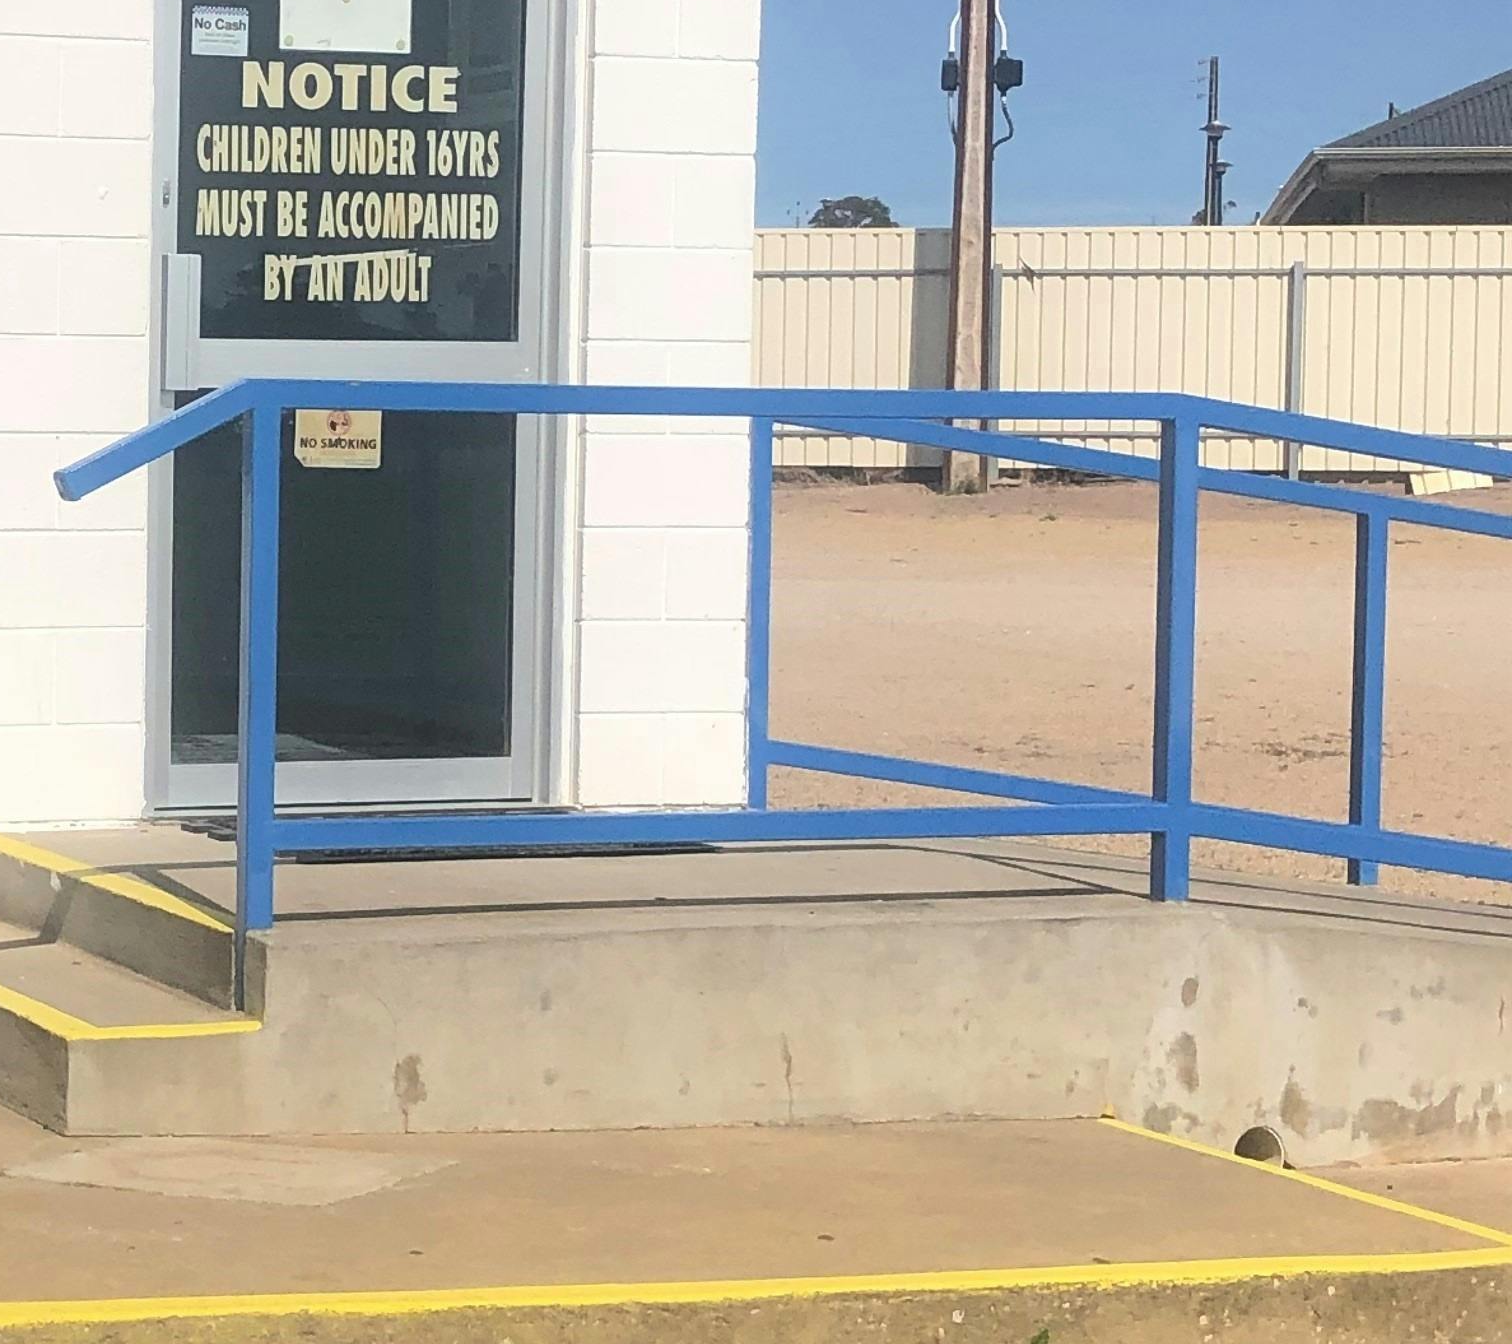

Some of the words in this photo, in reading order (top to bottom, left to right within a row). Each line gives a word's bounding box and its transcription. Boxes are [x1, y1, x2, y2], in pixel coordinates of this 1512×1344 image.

[194, 17, 212, 30] No
[215, 18, 247, 32] Cash
[242, 61, 460, 113] NOTICE
[196, 123, 321, 174] CHILDREN
[330, 128, 416, 176] UNDER
[426, 129, 500, 178] 16YRS
[195, 188, 267, 237] MUST
[277, 190, 309, 238] BE
[318, 191, 500, 240] ACCOMPANIED
[264, 254, 297, 302] BY
[307, 253, 344, 302] AN
[353, 251, 432, 303] ADULT
[300, 437, 317, 449] NO
[321, 438, 377, 450] SMOKING
